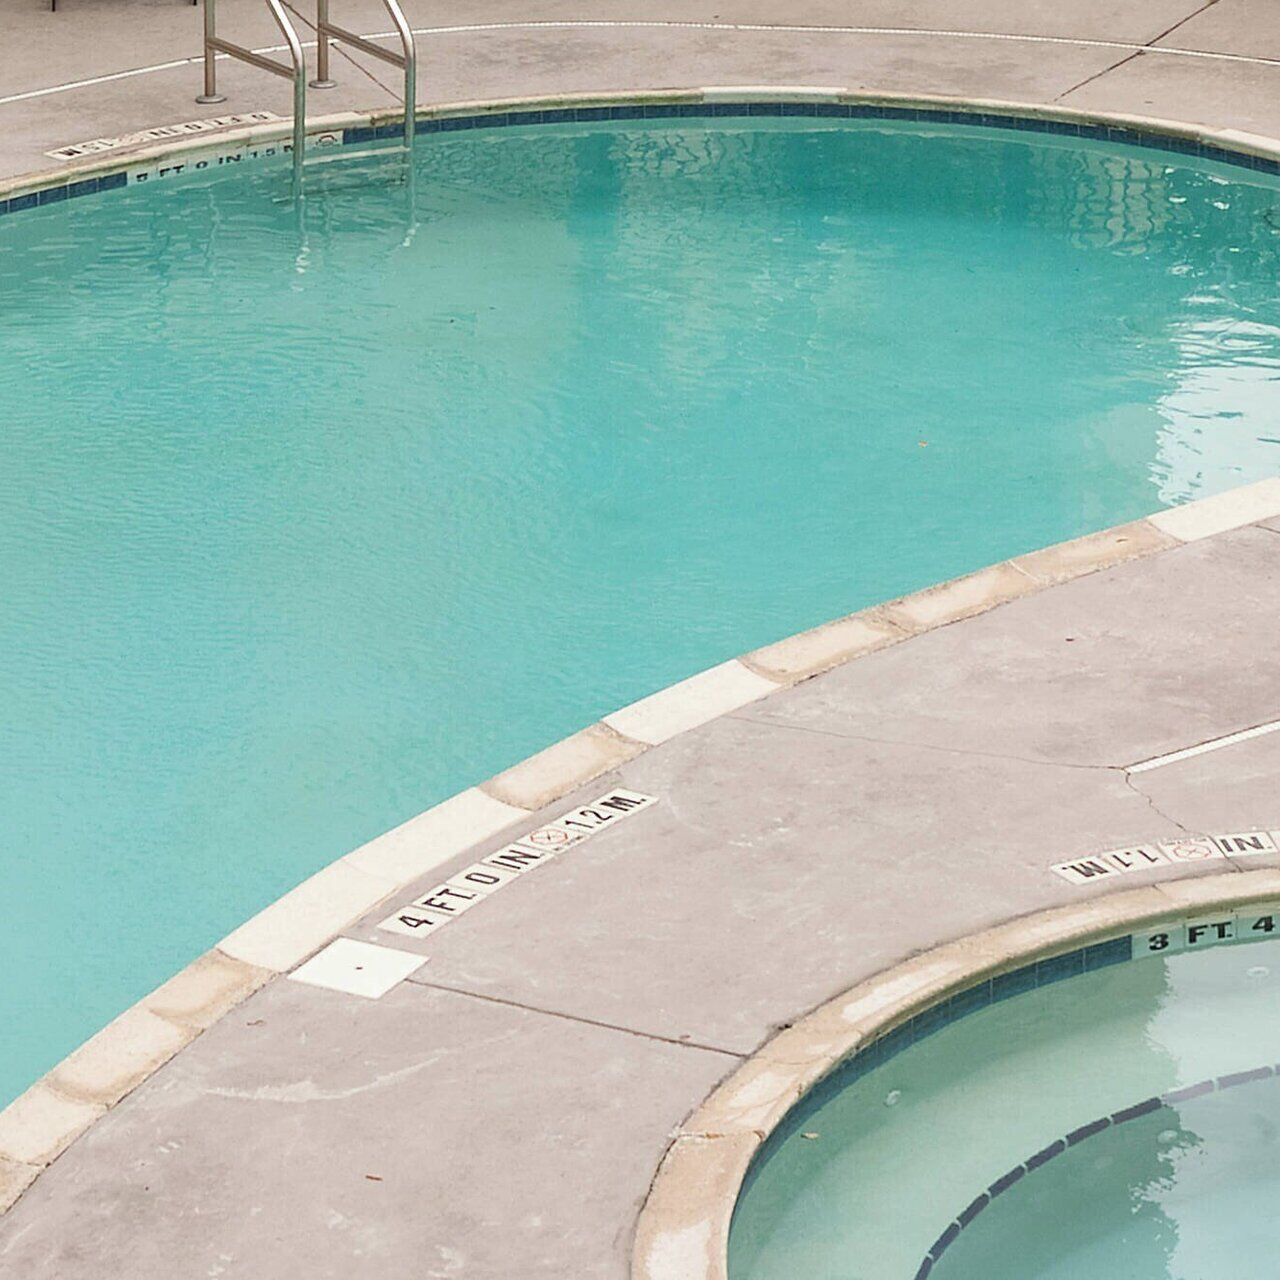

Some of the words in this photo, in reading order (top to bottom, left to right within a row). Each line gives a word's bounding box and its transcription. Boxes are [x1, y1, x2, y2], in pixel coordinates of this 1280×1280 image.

[399, 915, 434, 928] 4
[564, 809, 613, 829] 1.2
[599, 795, 646, 811] M.
[1148, 933, 1169, 950] 3
[1252, 915, 1276, 932] 4
